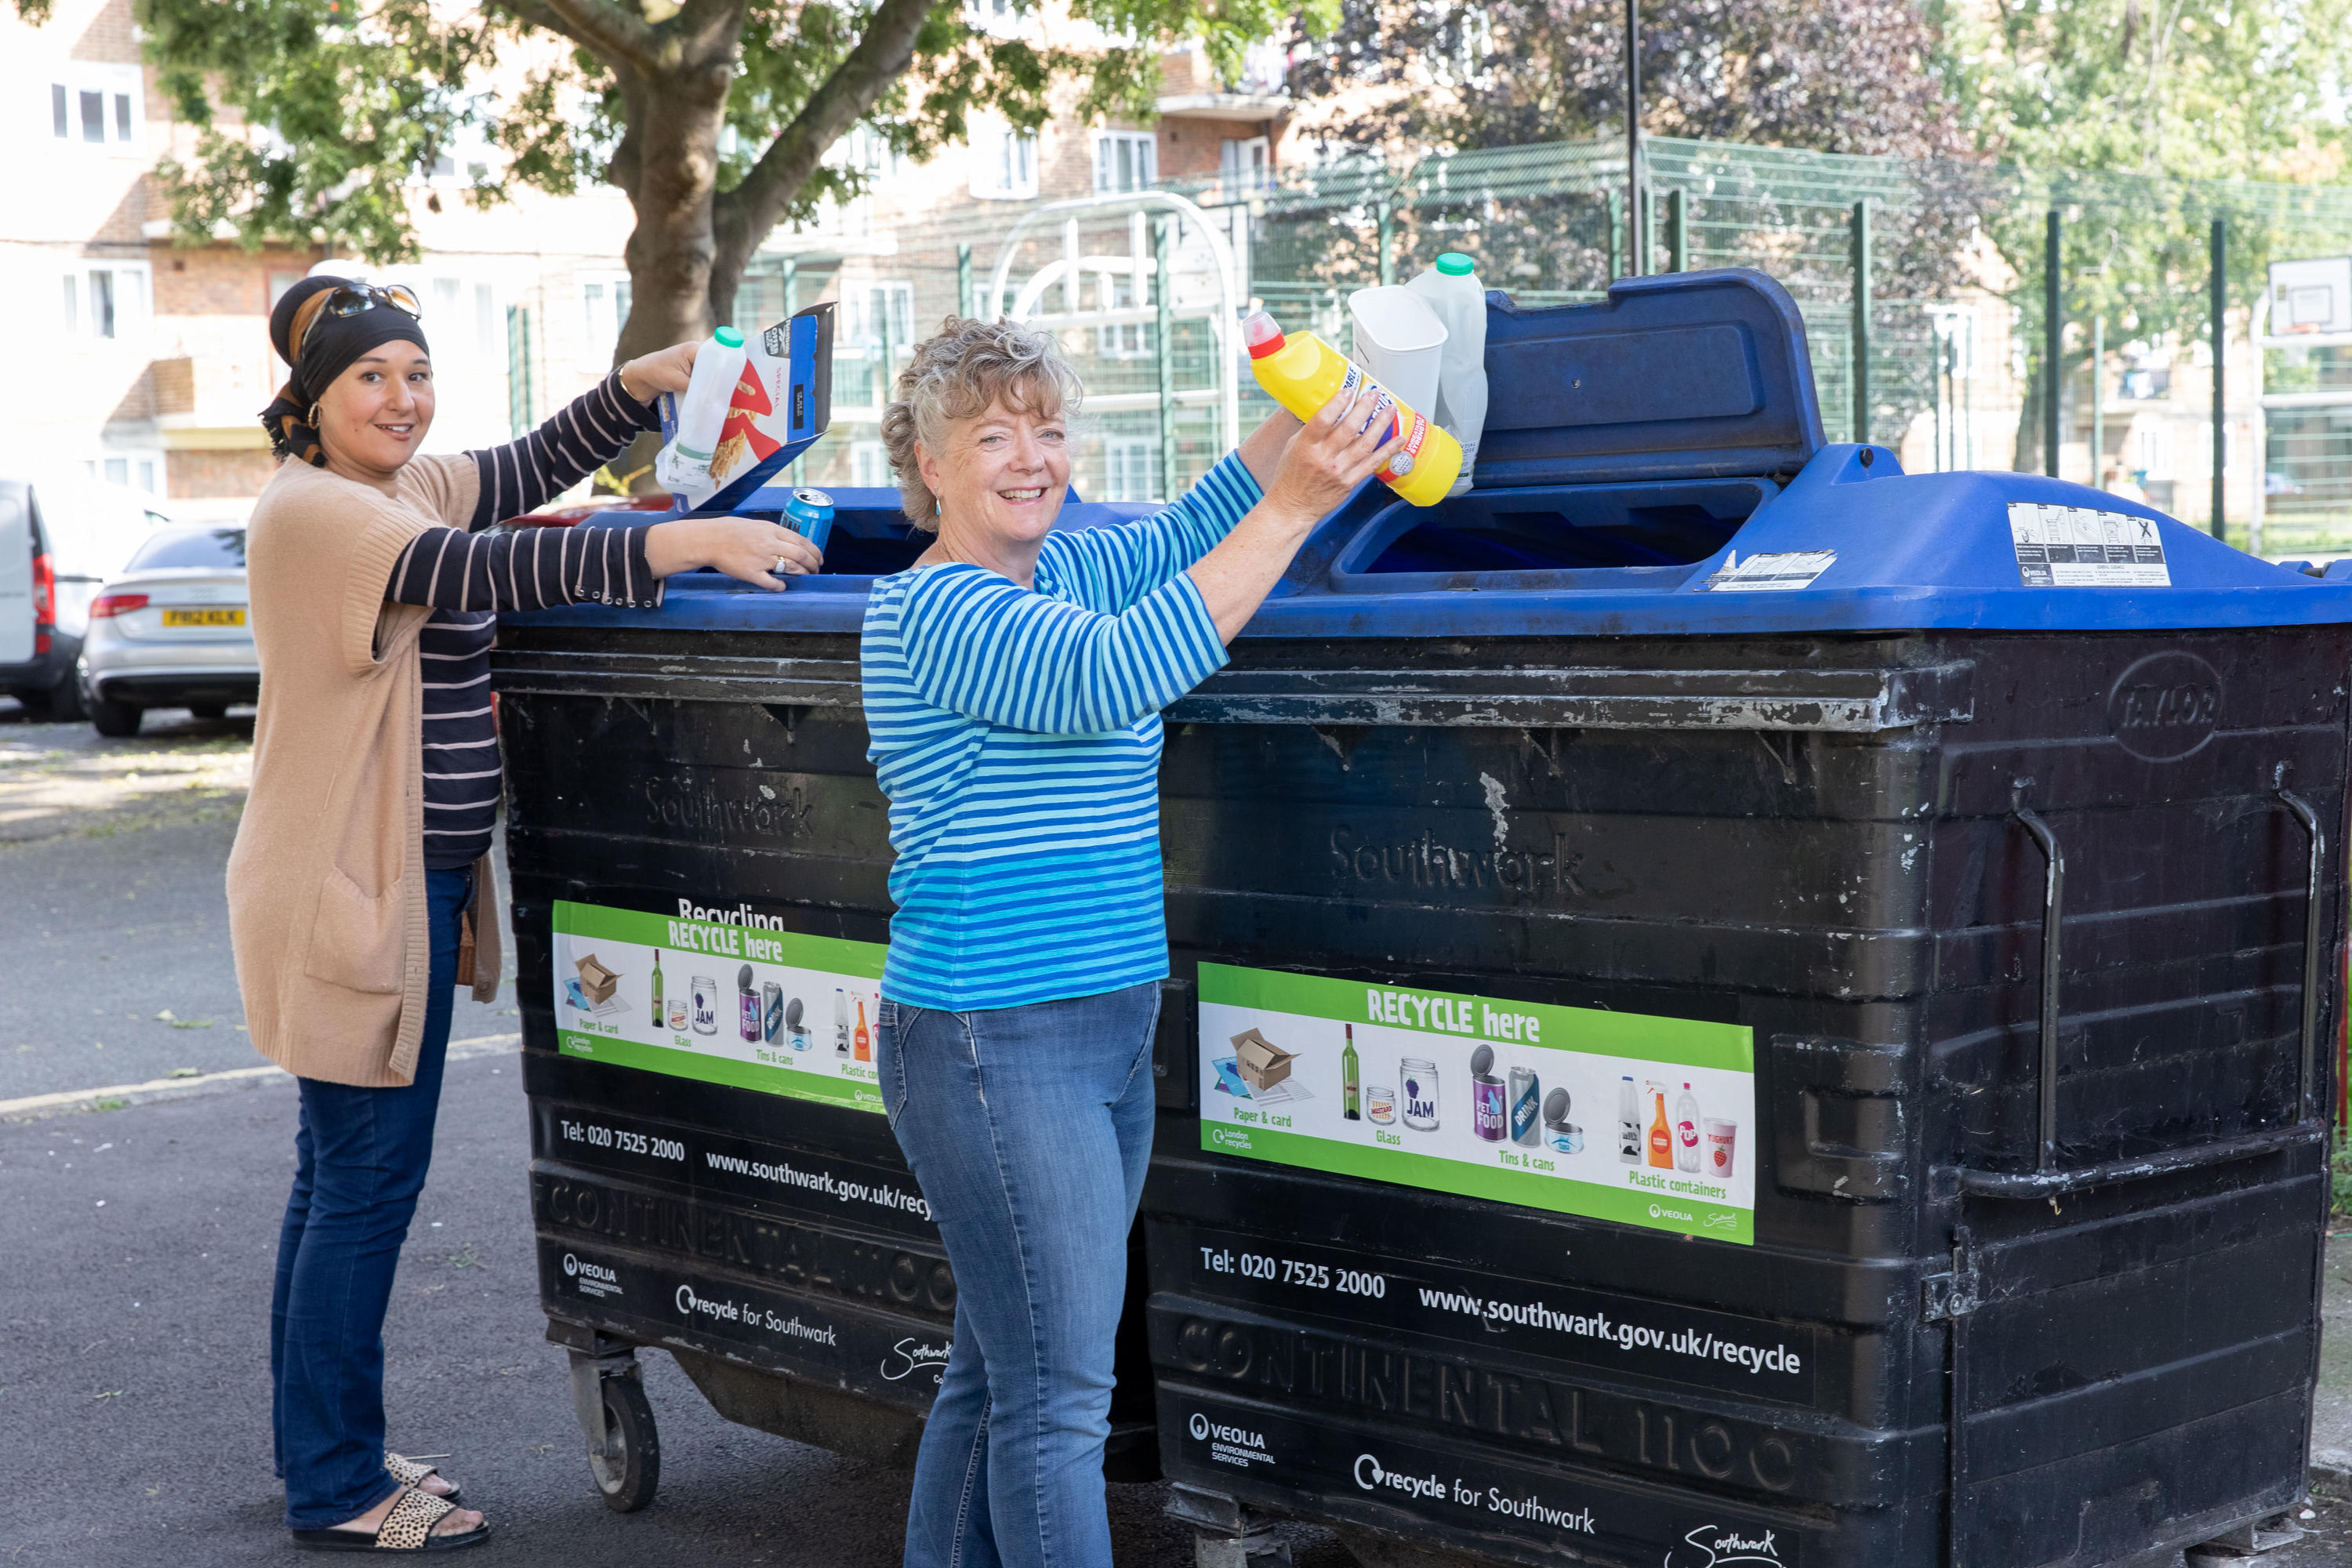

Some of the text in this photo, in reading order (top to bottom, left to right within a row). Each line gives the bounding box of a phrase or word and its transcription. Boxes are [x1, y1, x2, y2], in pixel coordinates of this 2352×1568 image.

[1410, 419, 1428, 456] STRENGTH
[1330, 824, 1586, 896] Southwark
[668, 920, 783, 962] RECYCLE here
[579, 1018, 597, 1033] Paper
[604, 1024, 619, 1034] card
[695, 1009, 714, 1024] JAM
[742, 1018, 760, 1033] FOOD
[766, 1006, 782, 1029] DRINK
[1367, 989, 1540, 1043] RECYCLE here
[674, 1035, 691, 1047] Glass
[756, 1049, 771, 1061] Tins
[779, 1054, 793, 1065] cans
[841, 1063, 866, 1078] Plastic
[1234, 1107, 1292, 1127] Paper & card
[1407, 1098, 1434, 1118] JAM
[1476, 1099, 1491, 1114] PET
[1515, 1096, 1538, 1127] DRINK
[1477, 1111, 1504, 1129] FOOD
[561, 1120, 684, 1162] Tel: 020 7525 2000
[1225, 1128, 1248, 1140] London
[1225, 1138, 1252, 1150] recycles
[1376, 1130, 1401, 1145] Glass
[1498, 1149, 1555, 1172] Tins & cans
[706, 1152, 934, 1222] www.southwark.gov.uk/recy
[1629, 1170, 1726, 1200] Plastic containers
[1661, 1209, 1693, 1221] VEOLIA
[578, 1263, 616, 1283] VEOLIA
[1200, 1247, 1385, 1298] Tel: 020 7525 2000
[579, 1277, 623, 1295] ENVIRONMENTAL
[579, 1284, 604, 1298] SERVICES
[697, 1297, 837, 1347] recycle for Southwark
[1418, 1288, 1801, 1374] www.southwark.gov.uk/recycle
[1178, 1316, 1603, 1454] CONTINENTAL
[1210, 1423, 1265, 1450] VEOLIA
[1212, 1443, 1276, 1465] ENVIRONMENTAL
[1212, 1452, 1248, 1467] SERVICES
[1385, 1470, 1595, 1534] recycle for Southwark
[1664, 1524, 1779, 1568] Southwark
